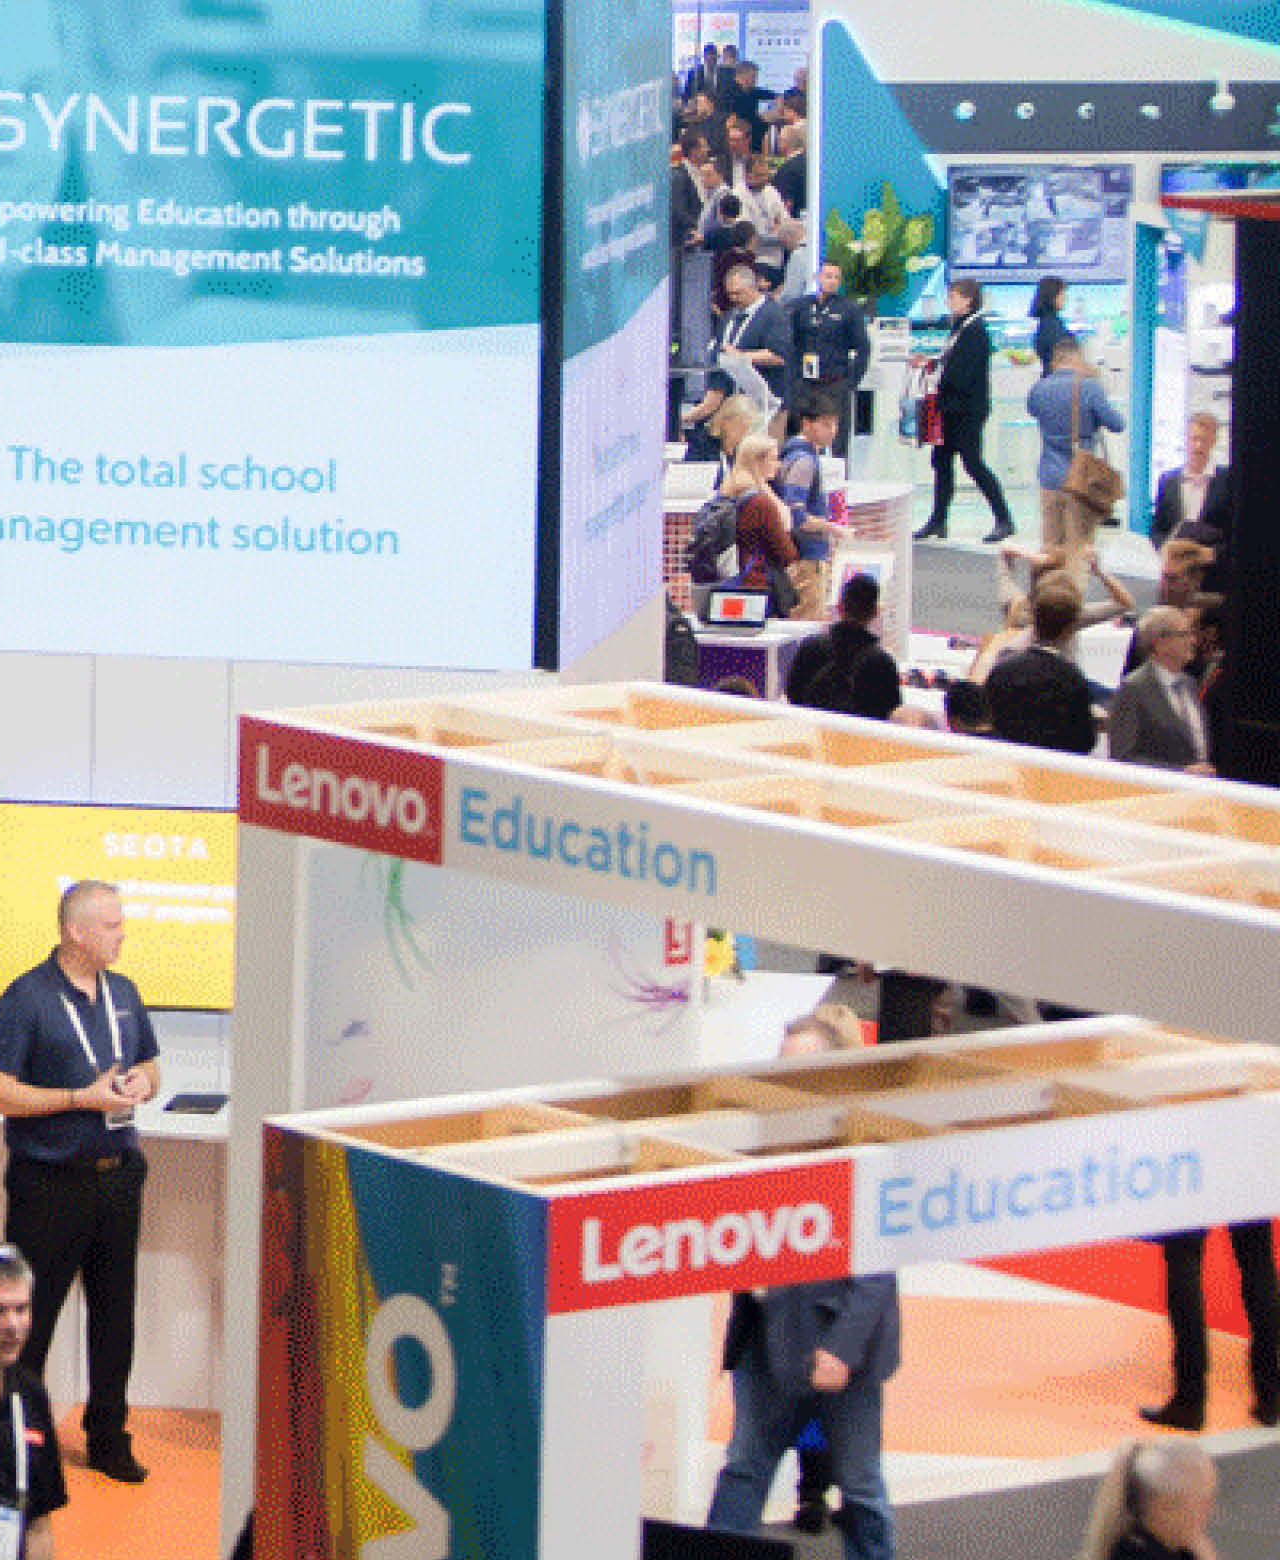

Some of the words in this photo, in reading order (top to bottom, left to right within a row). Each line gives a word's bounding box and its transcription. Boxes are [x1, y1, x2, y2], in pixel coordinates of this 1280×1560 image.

[139, 200, 280, 231] Education
[288, 203, 401, 239] through
[96, 242, 282, 276] Management
[289, 248, 426, 277] Solutions
[8, 445, 83, 484] The
[96, 452, 187, 487] total
[200, 456, 337, 493] school
[233, 515, 400, 554] solution
[257, 743, 428, 834] Lenovo
[459, 786, 718, 896] Education
[581, 1203, 833, 1283] Lenovo
[878, 1148, 1203, 1237] Education
